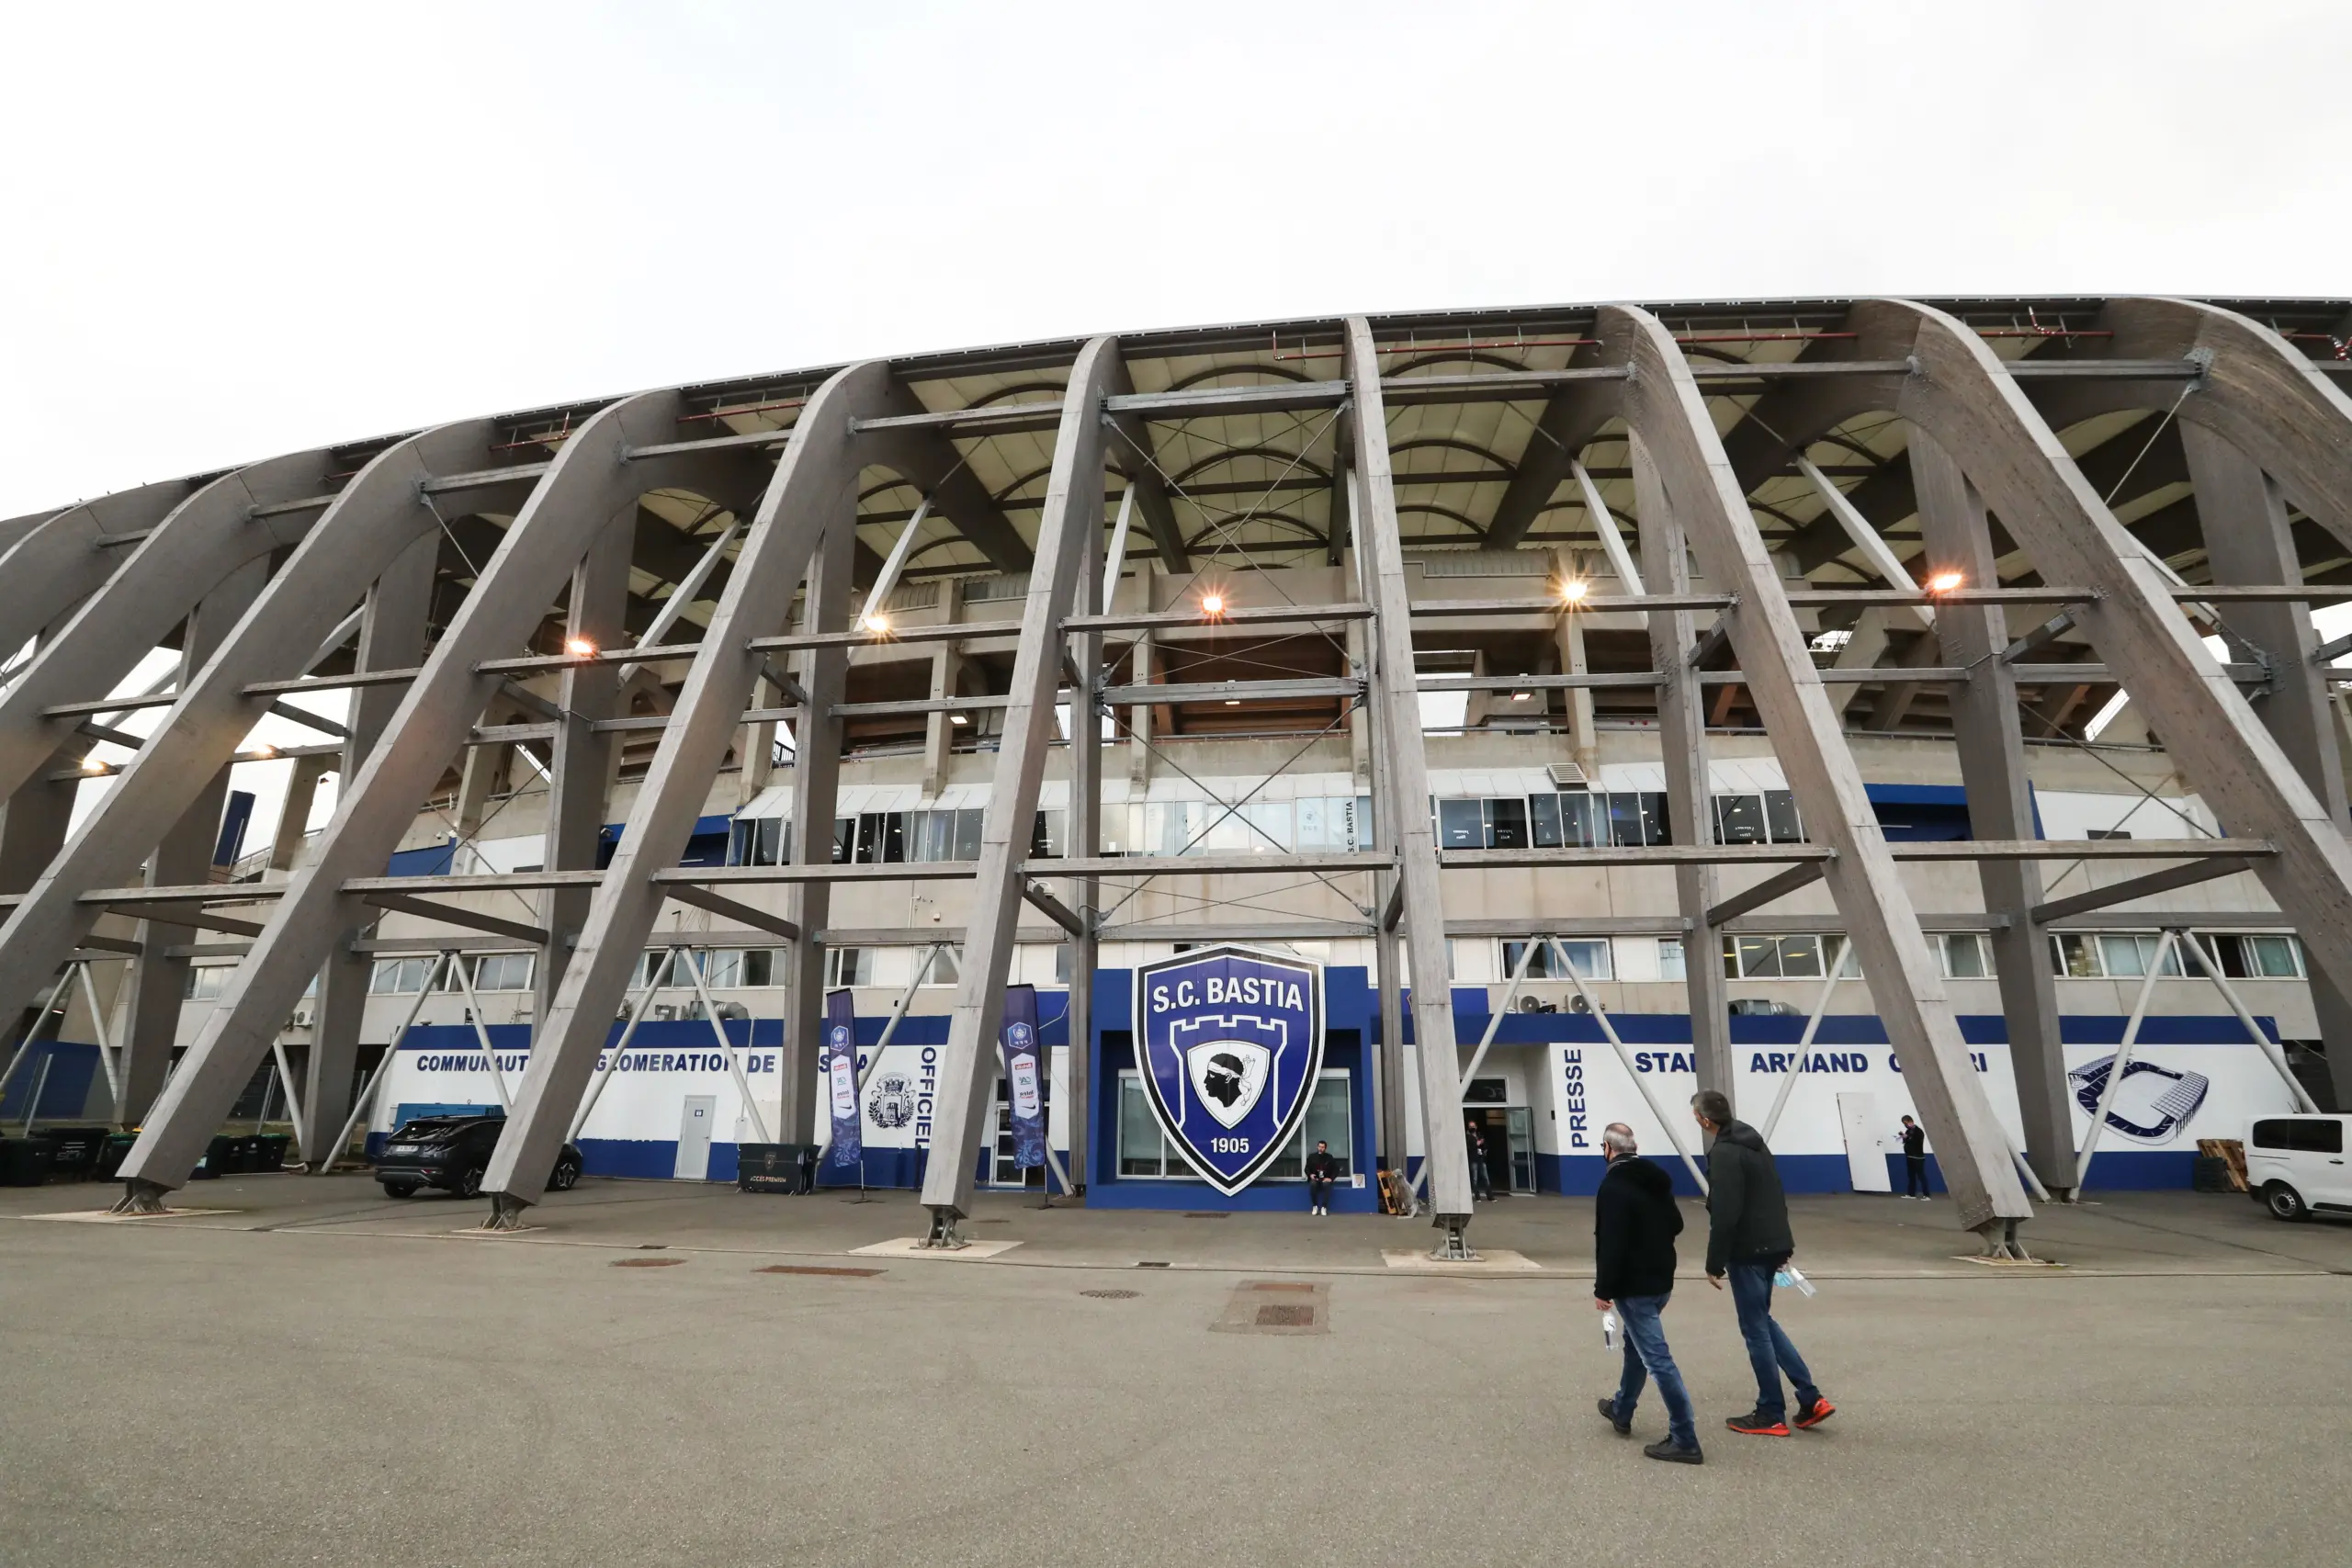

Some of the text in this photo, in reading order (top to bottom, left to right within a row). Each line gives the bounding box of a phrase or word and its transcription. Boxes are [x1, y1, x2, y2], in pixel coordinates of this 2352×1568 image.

[1153, 976, 1305, 1013] S.C. BASTIA
[416, 1055, 530, 1072] COMMUNAUT
[747, 1055, 775, 1073] DE
[1635, 1053, 1696, 1073] STA
[915, 1047, 936, 1149] OFFICIEL
[1565, 1049, 1589, 1148] PRESSE
[1210, 1137, 1250, 1154] 1905
